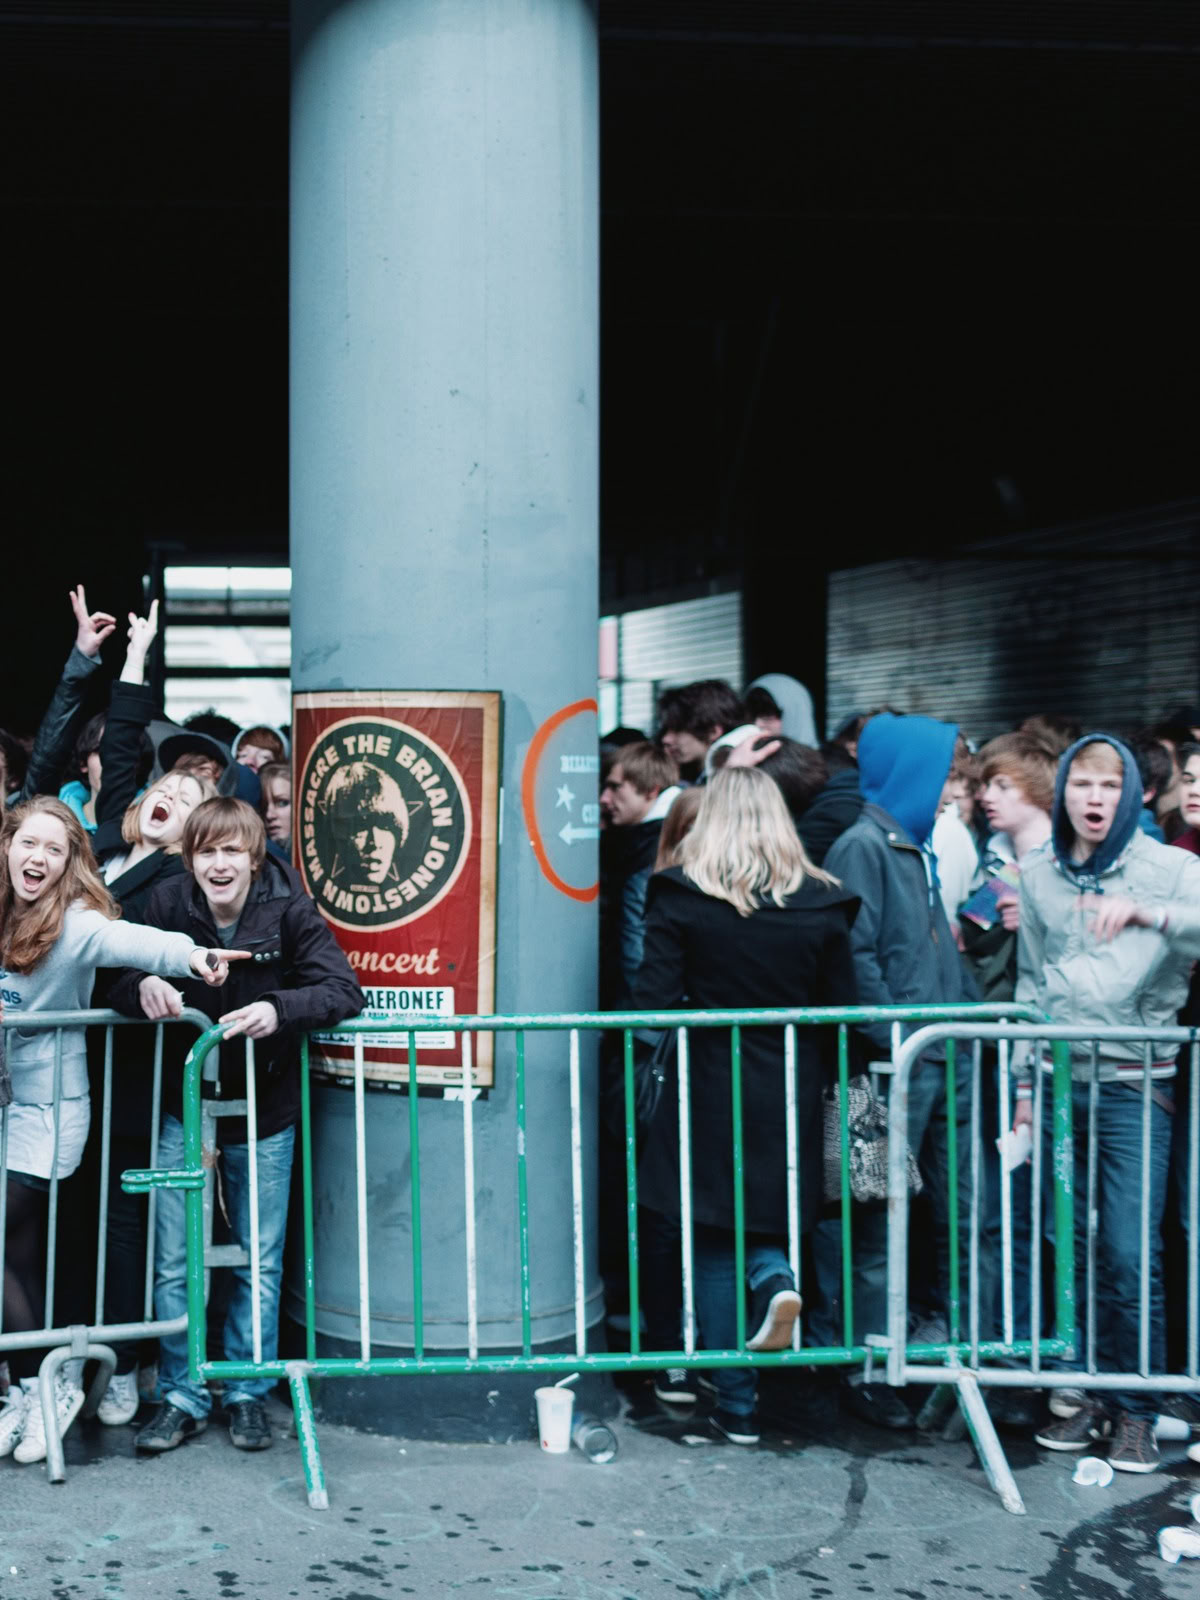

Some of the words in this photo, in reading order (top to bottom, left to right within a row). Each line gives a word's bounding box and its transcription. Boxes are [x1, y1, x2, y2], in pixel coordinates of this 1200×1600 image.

[343, 734, 392, 757] THE
[395, 744, 453, 827] BRIAN
[304, 745, 340, 882] MASSACRE
[323, 835, 450, 914] JONESTOWN
[344, 947, 440, 975] oncert
[366, 989, 445, 1010] AERONEF
